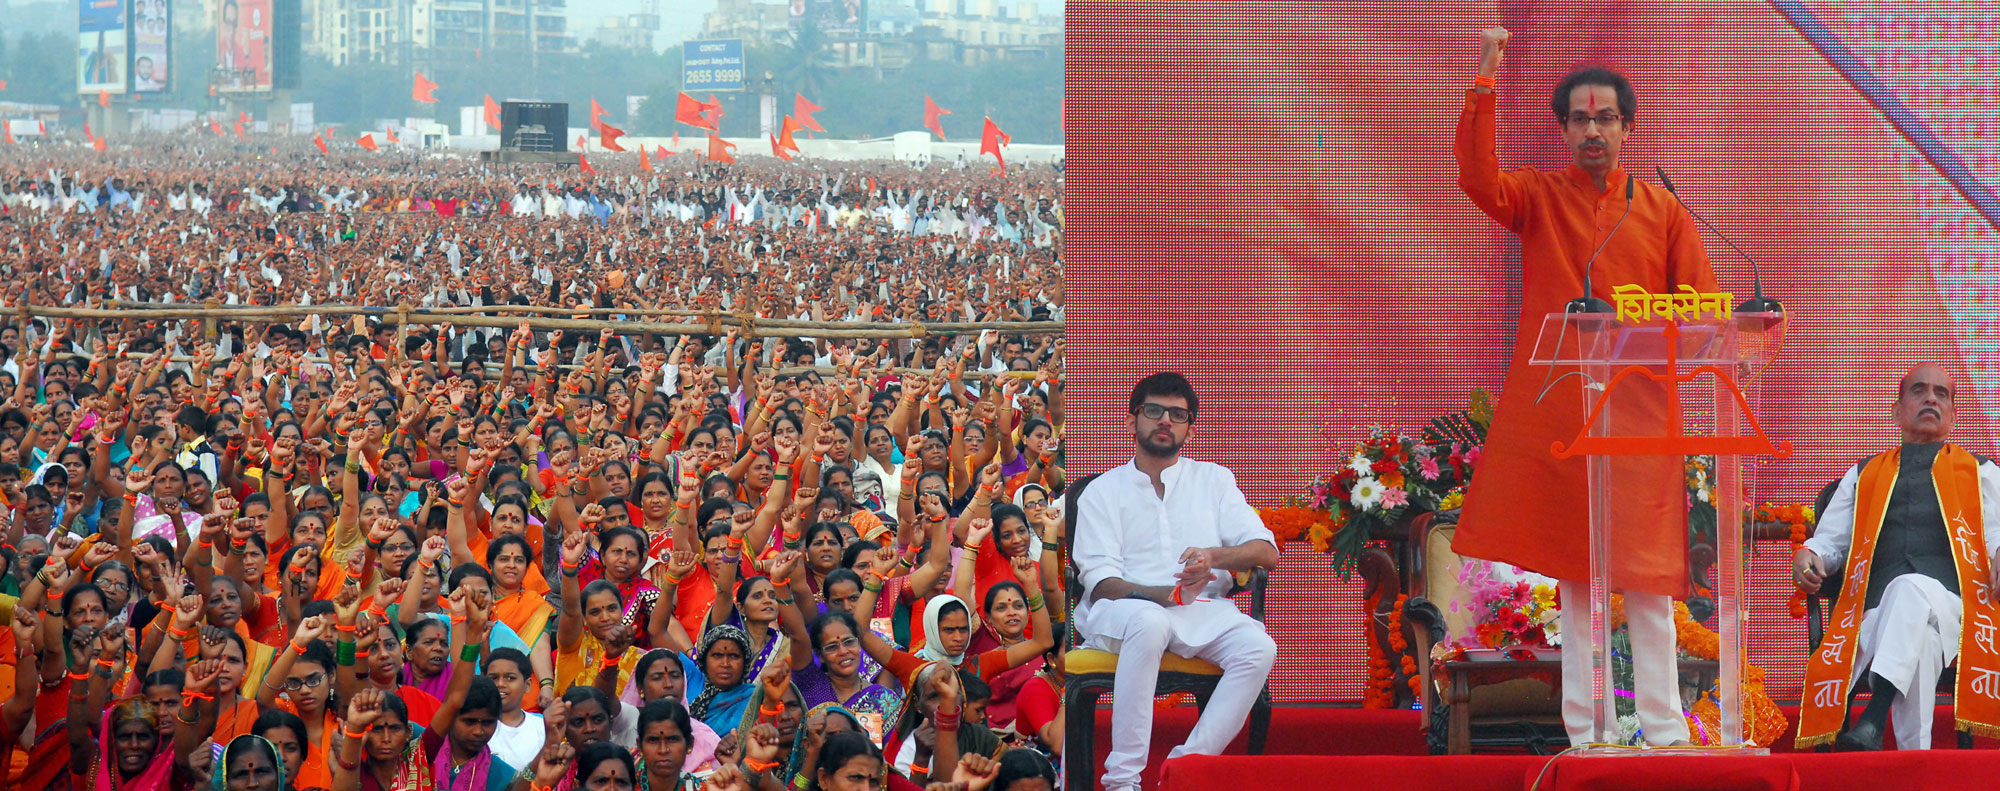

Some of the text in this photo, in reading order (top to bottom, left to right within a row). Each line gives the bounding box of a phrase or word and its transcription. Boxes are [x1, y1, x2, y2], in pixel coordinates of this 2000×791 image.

[700, 44, 725, 52] CONTACT
[686, 69, 741, 83] 2655 9999
[1611, 284, 1734, 324] शिवसेना
